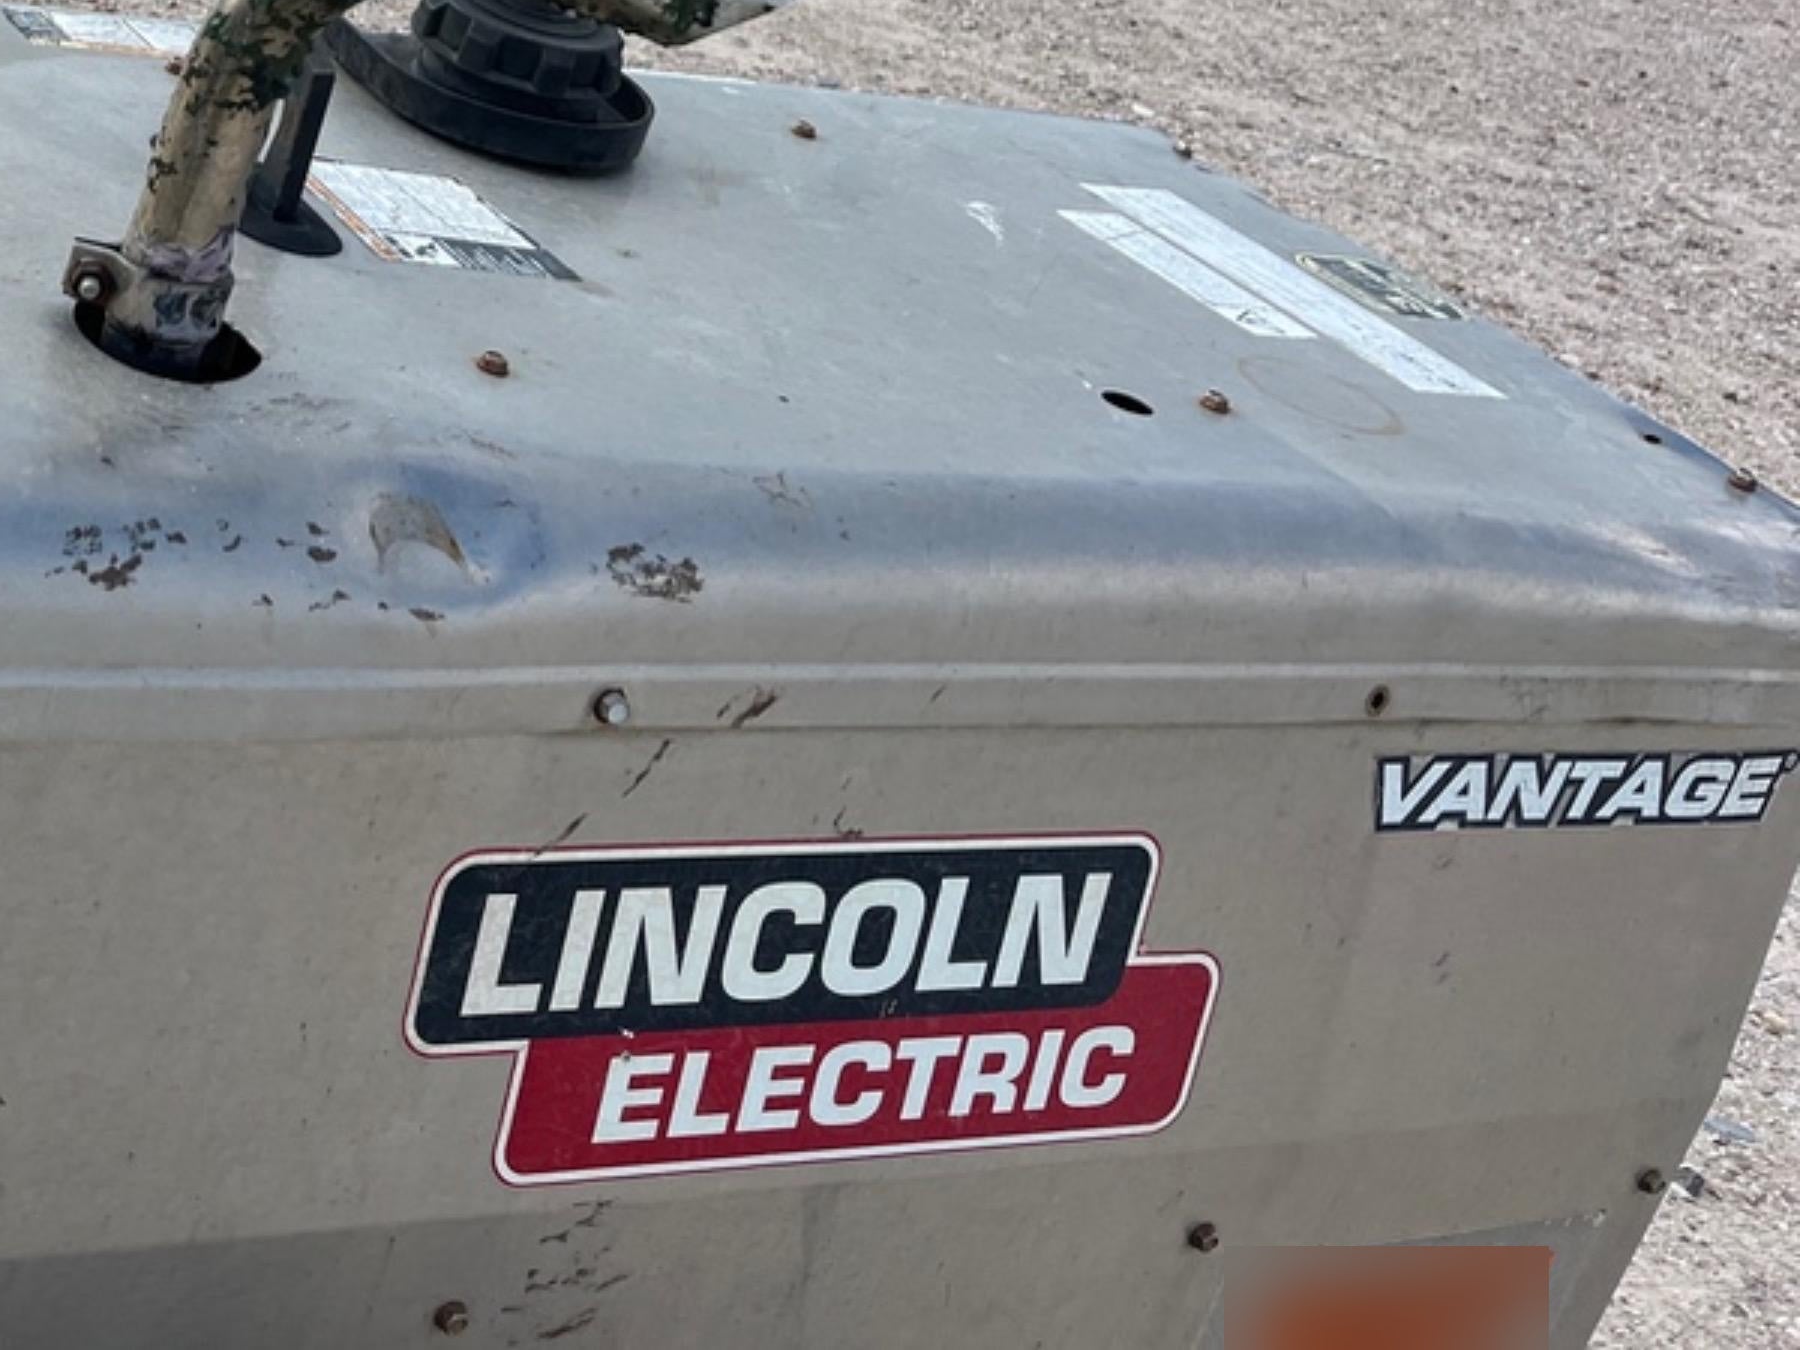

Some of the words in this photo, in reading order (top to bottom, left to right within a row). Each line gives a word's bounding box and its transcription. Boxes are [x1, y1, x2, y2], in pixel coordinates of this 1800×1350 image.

[1380, 755, 1784, 825] VANTAGE
[459, 871, 1114, 1017] LINCOLN
[589, 1024, 1136, 1146] ELECTRIC
